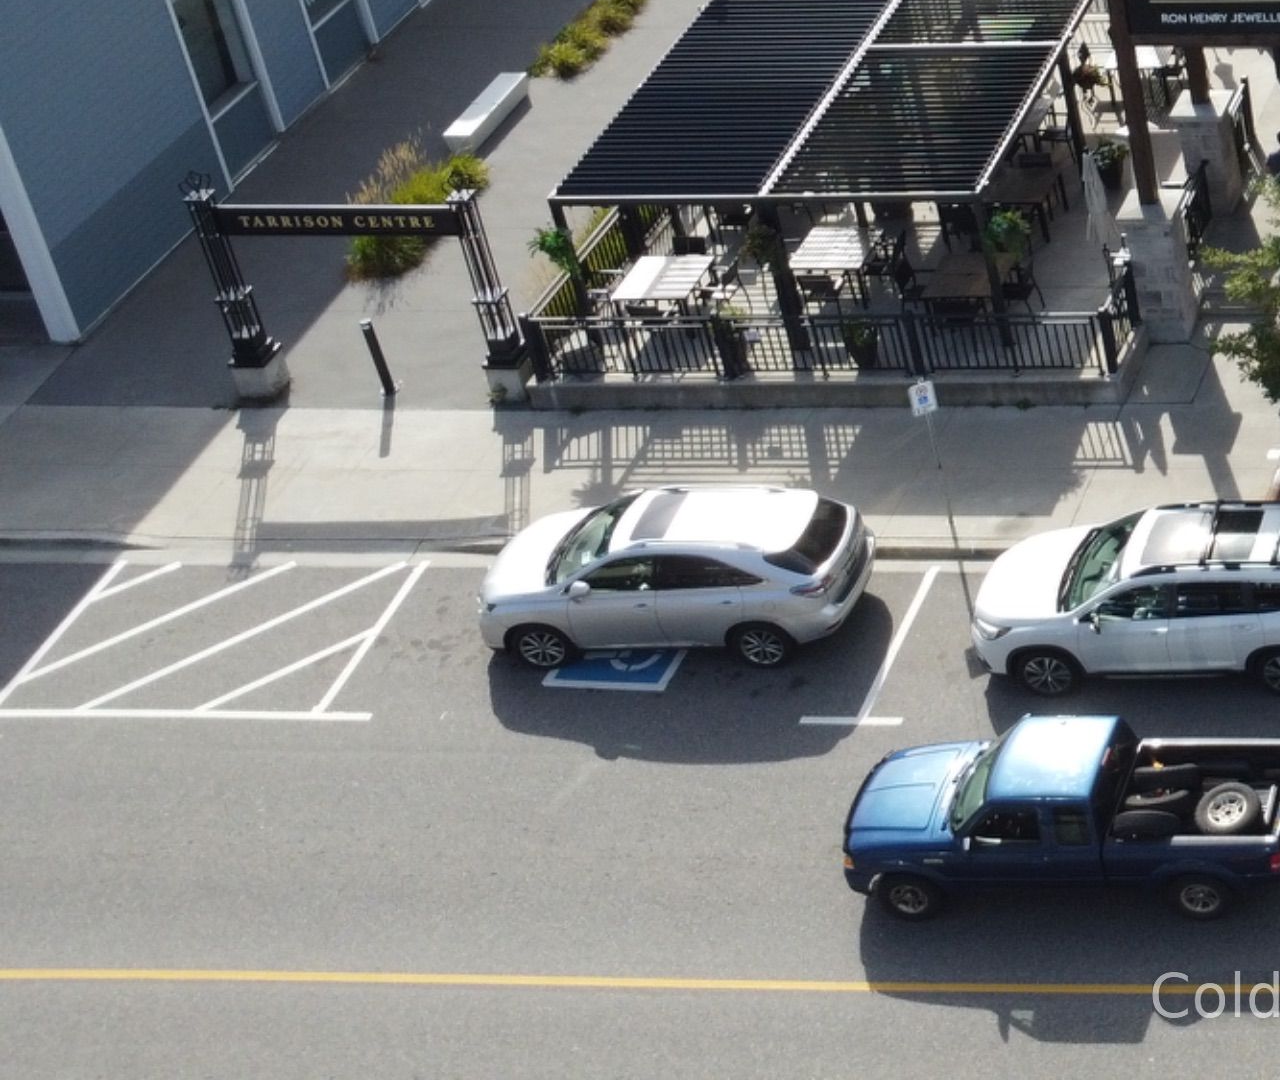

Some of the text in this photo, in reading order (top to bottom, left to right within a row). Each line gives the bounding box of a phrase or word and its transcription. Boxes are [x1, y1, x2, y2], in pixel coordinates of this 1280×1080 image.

[1160, 13, 1187, 23] RON
[1189, 13, 1228, 23] HENRY
[237, 215, 436, 228] TARRISON CENTRE
